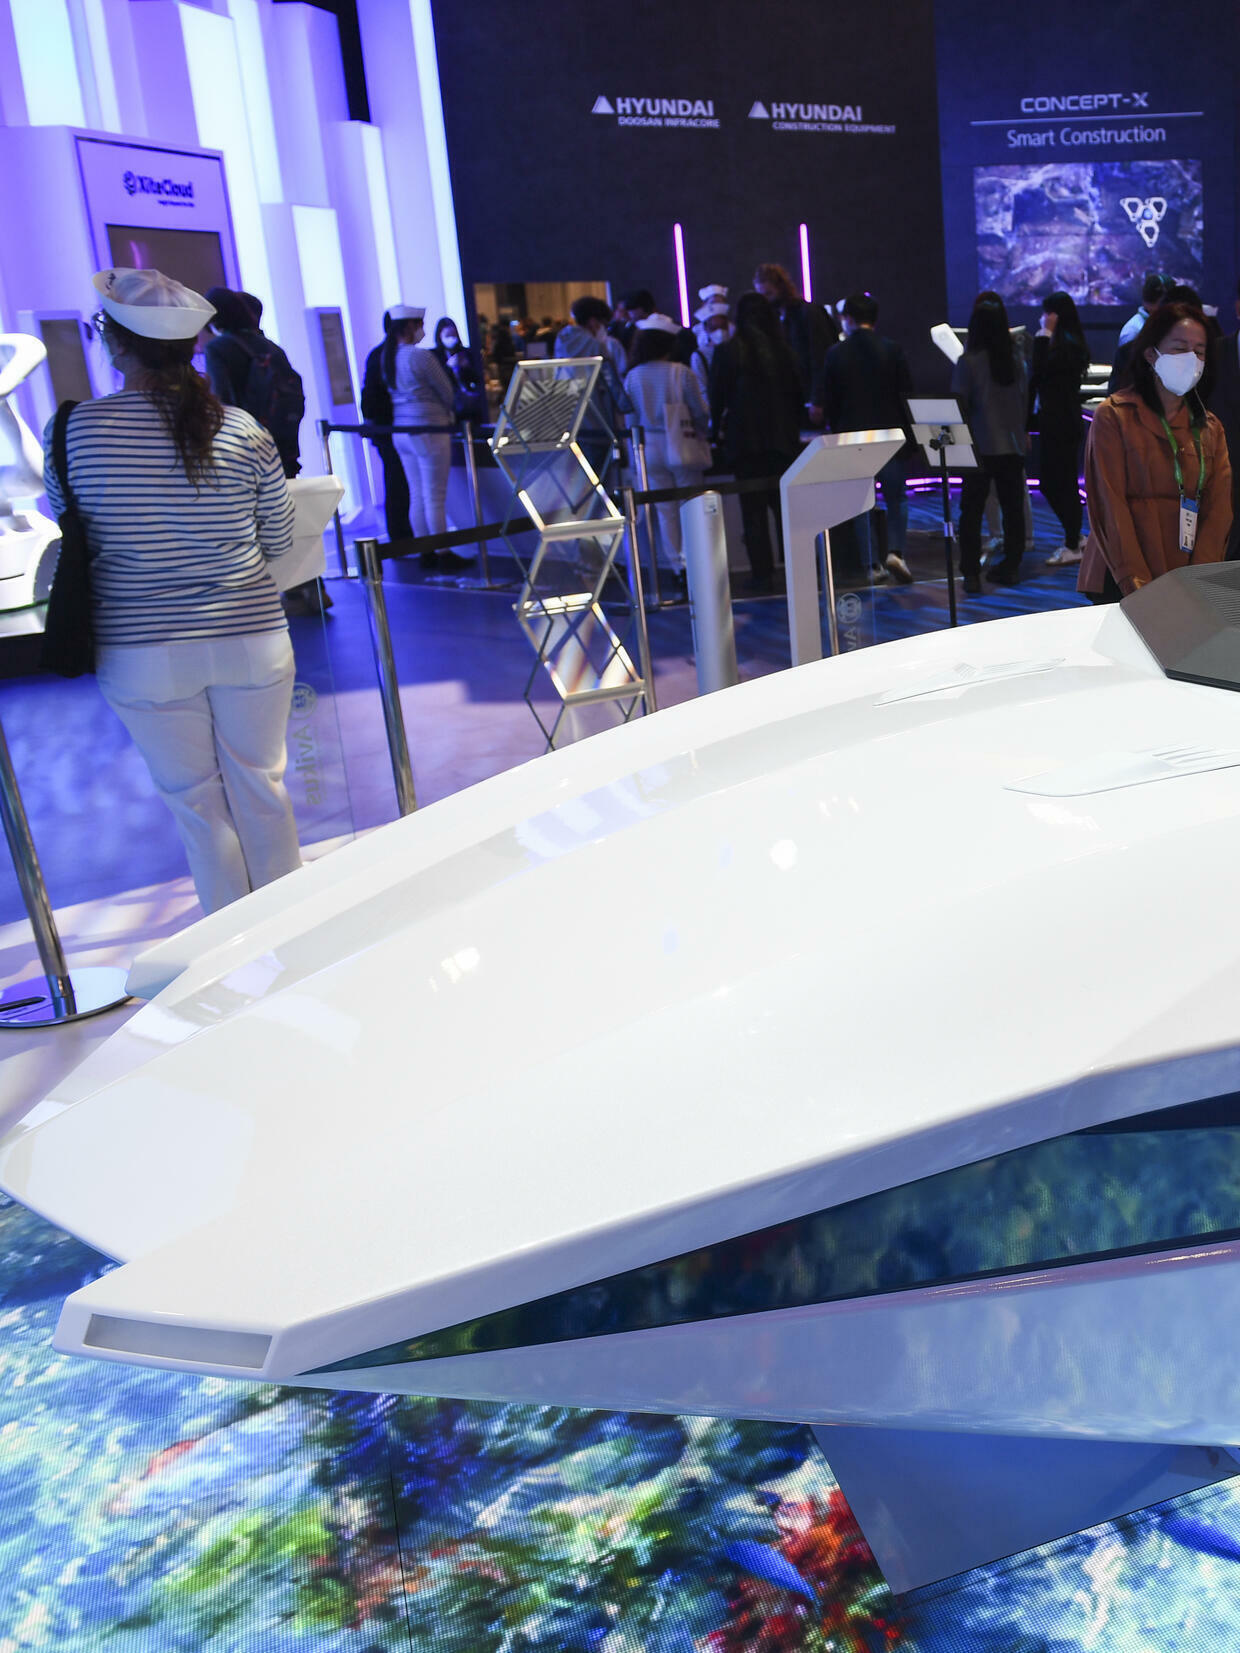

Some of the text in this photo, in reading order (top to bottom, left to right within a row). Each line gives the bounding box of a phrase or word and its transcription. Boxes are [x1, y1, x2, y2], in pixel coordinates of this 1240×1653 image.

[616, 97, 714, 117] HYUNDAI
[771, 102, 862, 121] HYUNDAI
[1020, 92, 1149, 113] CONCEPT-X
[618, 116, 662, 126] DOOSAN
[772, 121, 842, 132] CONSTRUCTION
[1007, 125, 1166, 147] Smart Construction
